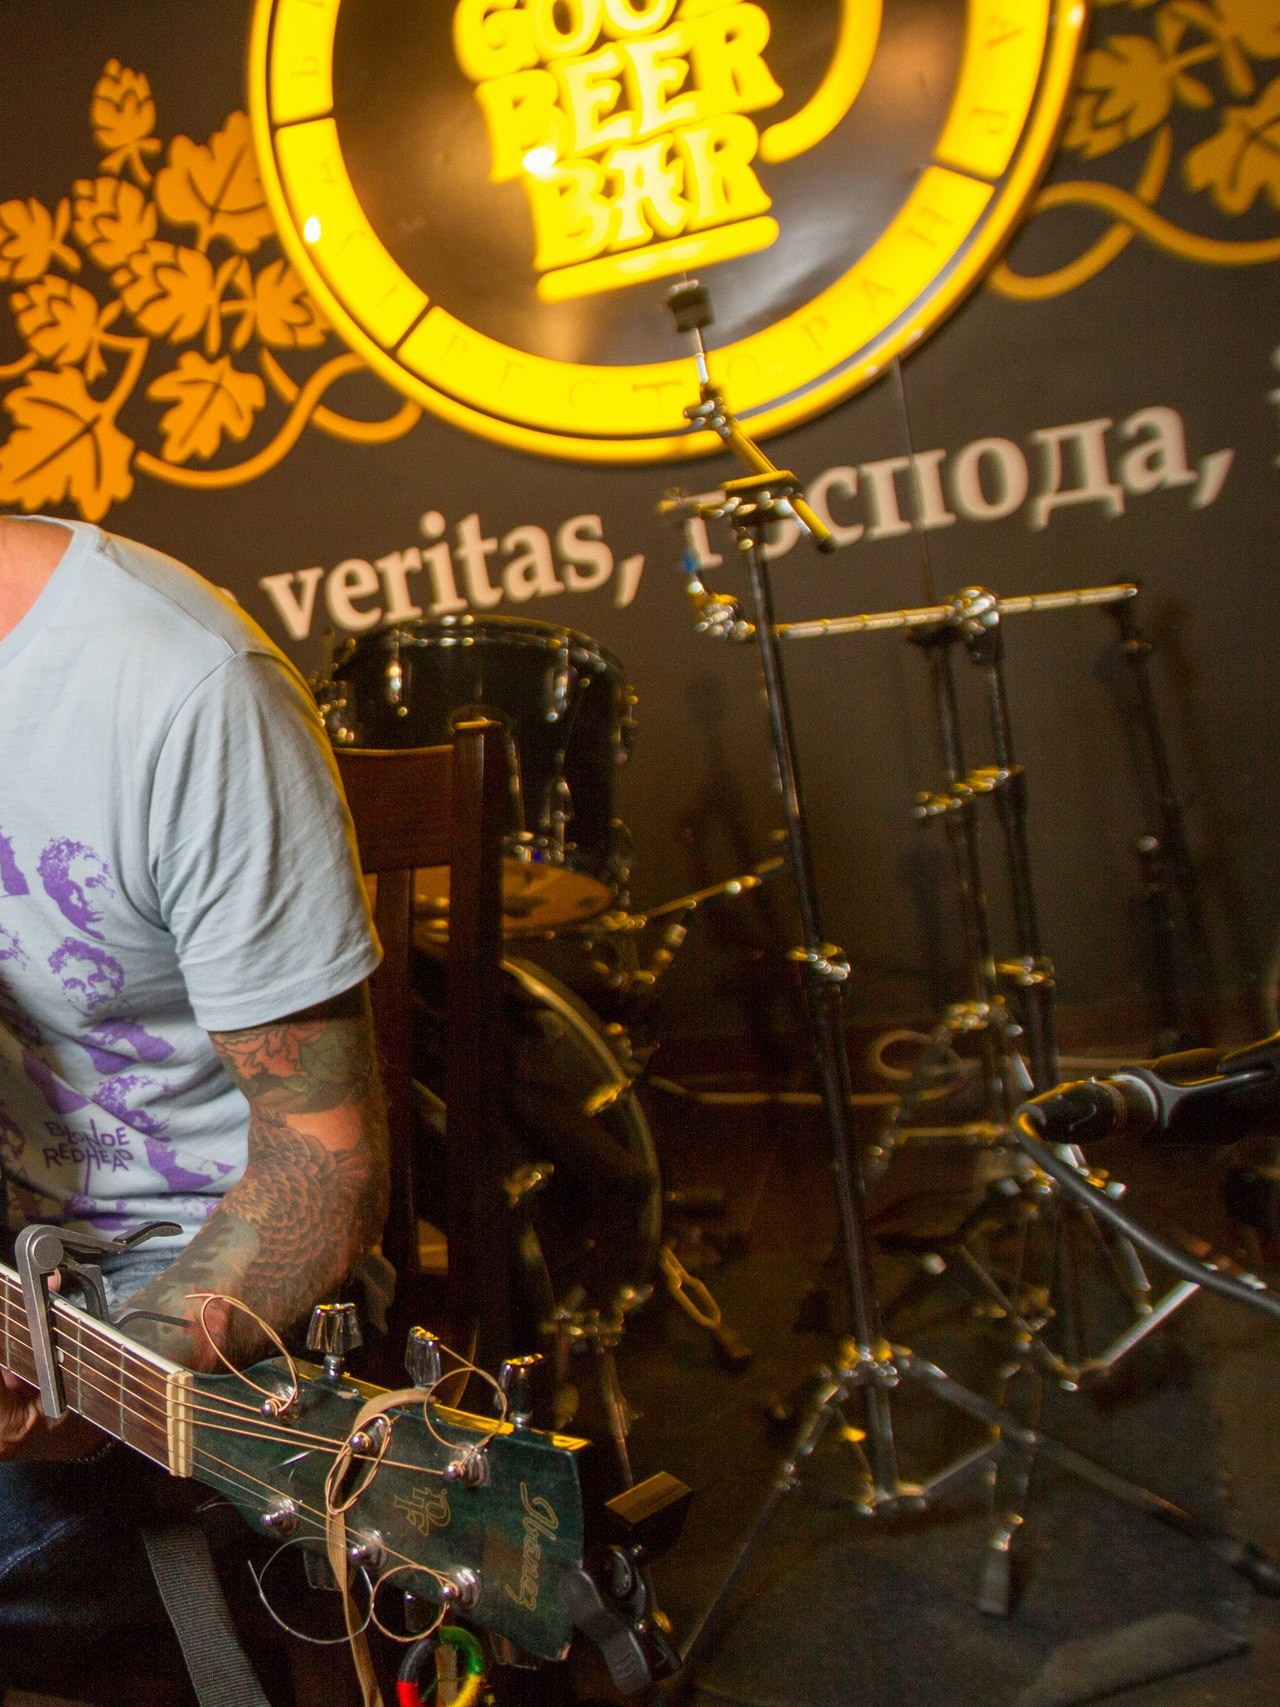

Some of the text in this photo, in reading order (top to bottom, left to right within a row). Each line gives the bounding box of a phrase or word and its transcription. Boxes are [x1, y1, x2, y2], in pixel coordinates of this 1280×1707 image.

[453, 0, 747, 82] GO
[475, 2, 784, 184] BEER
[525, 113, 773, 272] BAR
[258, 509, 646, 642] veritas,
[42, 1140, 135, 1187] REDHEAD
[44, 1118, 131, 1149] BLONDE
[505, 1481, 560, 1612] Ibanez
